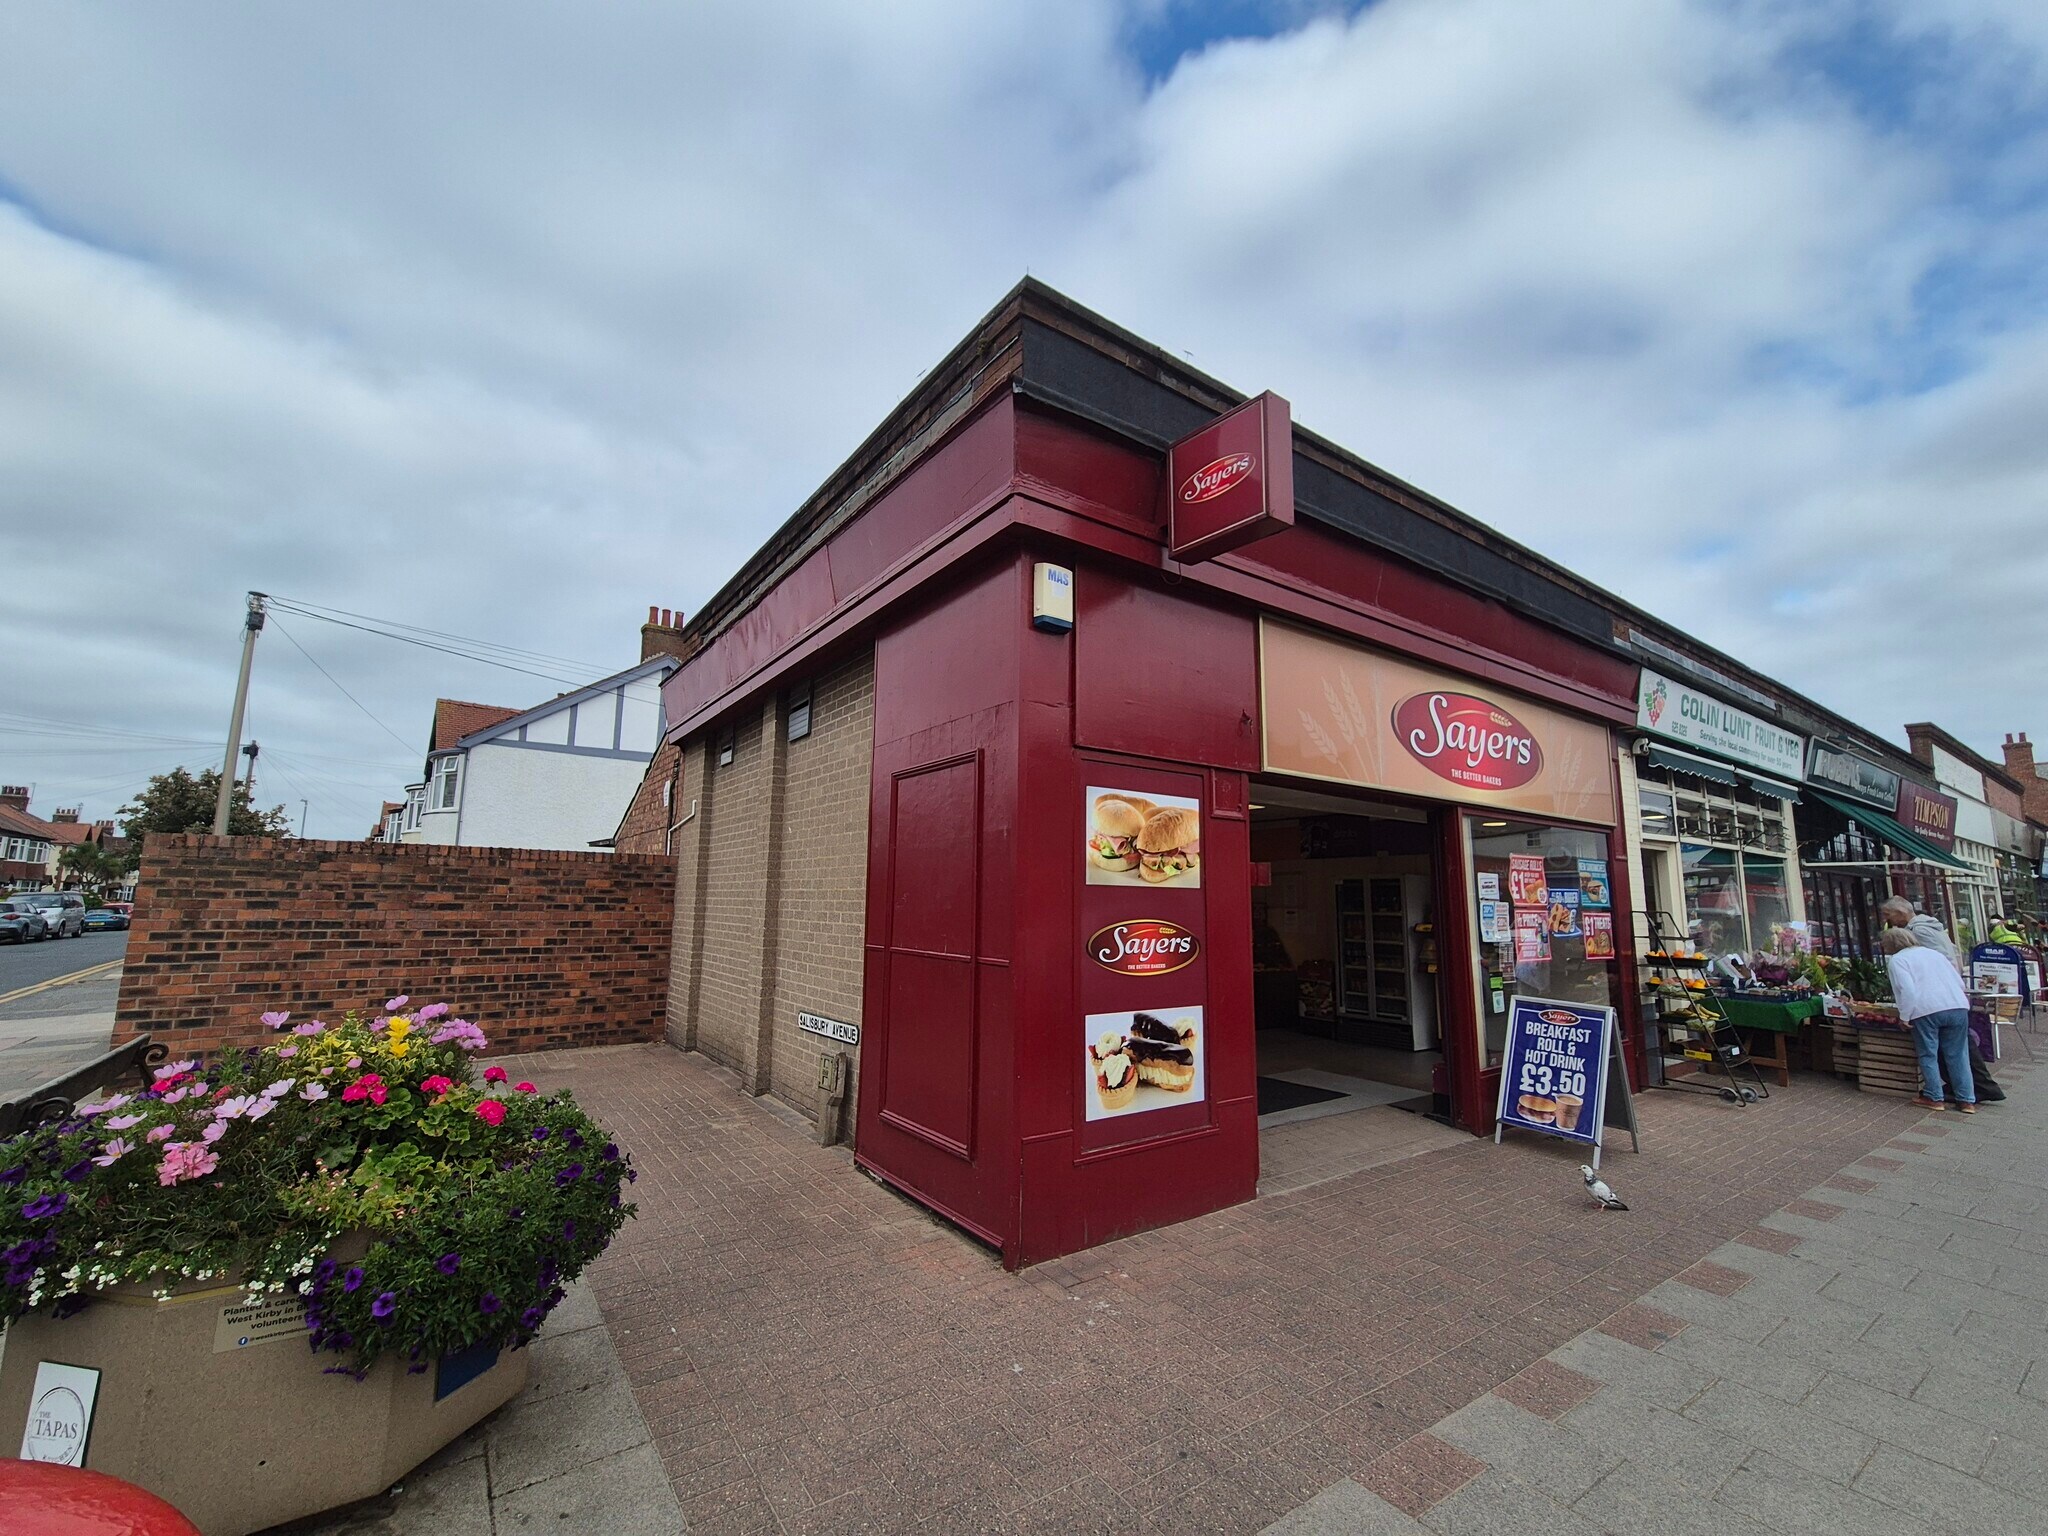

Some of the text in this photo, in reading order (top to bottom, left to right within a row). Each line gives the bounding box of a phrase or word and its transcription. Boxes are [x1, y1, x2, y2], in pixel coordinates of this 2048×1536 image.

[1184, 455, 1250, 501] Sayers
[1048, 568, 1069, 586] MAS
[1410, 695, 1532, 768] Sayers
[1680, 693, 1799, 760] COLIN LUNT FRUIT & VEG
[1699, 729, 1718, 746] Serving
[1718, 736, 1727, 747] the
[1727, 739, 1738, 751] local
[1738, 745, 1761, 760] community
[1451, 768, 1502, 786] THE BETTER BAKERS
[1914, 796, 1950, 829] TIMPSON
[1511, 871, 1526, 900] £1
[1585, 916, 1594, 936] £1
[1594, 916, 1611, 930] TREATS
[1098, 926, 1192, 963] Sayers
[1543, 1011, 1576, 1021] Sayers
[799, 1014, 856, 1042] SALISBURY AVENUE
[1525, 1021, 1592, 1044] BREAKFAST
[1536, 1037, 1576, 1056] ROLL &
[1524, 1049, 1586, 1072] HOT DRINK
[1519, 1063, 1587, 1096] £3.50
[223, 1303, 262, 1316] Planted
[264, 1301, 272, 1309] &
[227, 1314, 252, 1325] West
[255, 1309, 282, 1320] Kirby
[284, 1305, 294, 1314] in
[251, 1314, 303, 1330] volunteers
[35, 1419, 78, 1439] TAPAS
